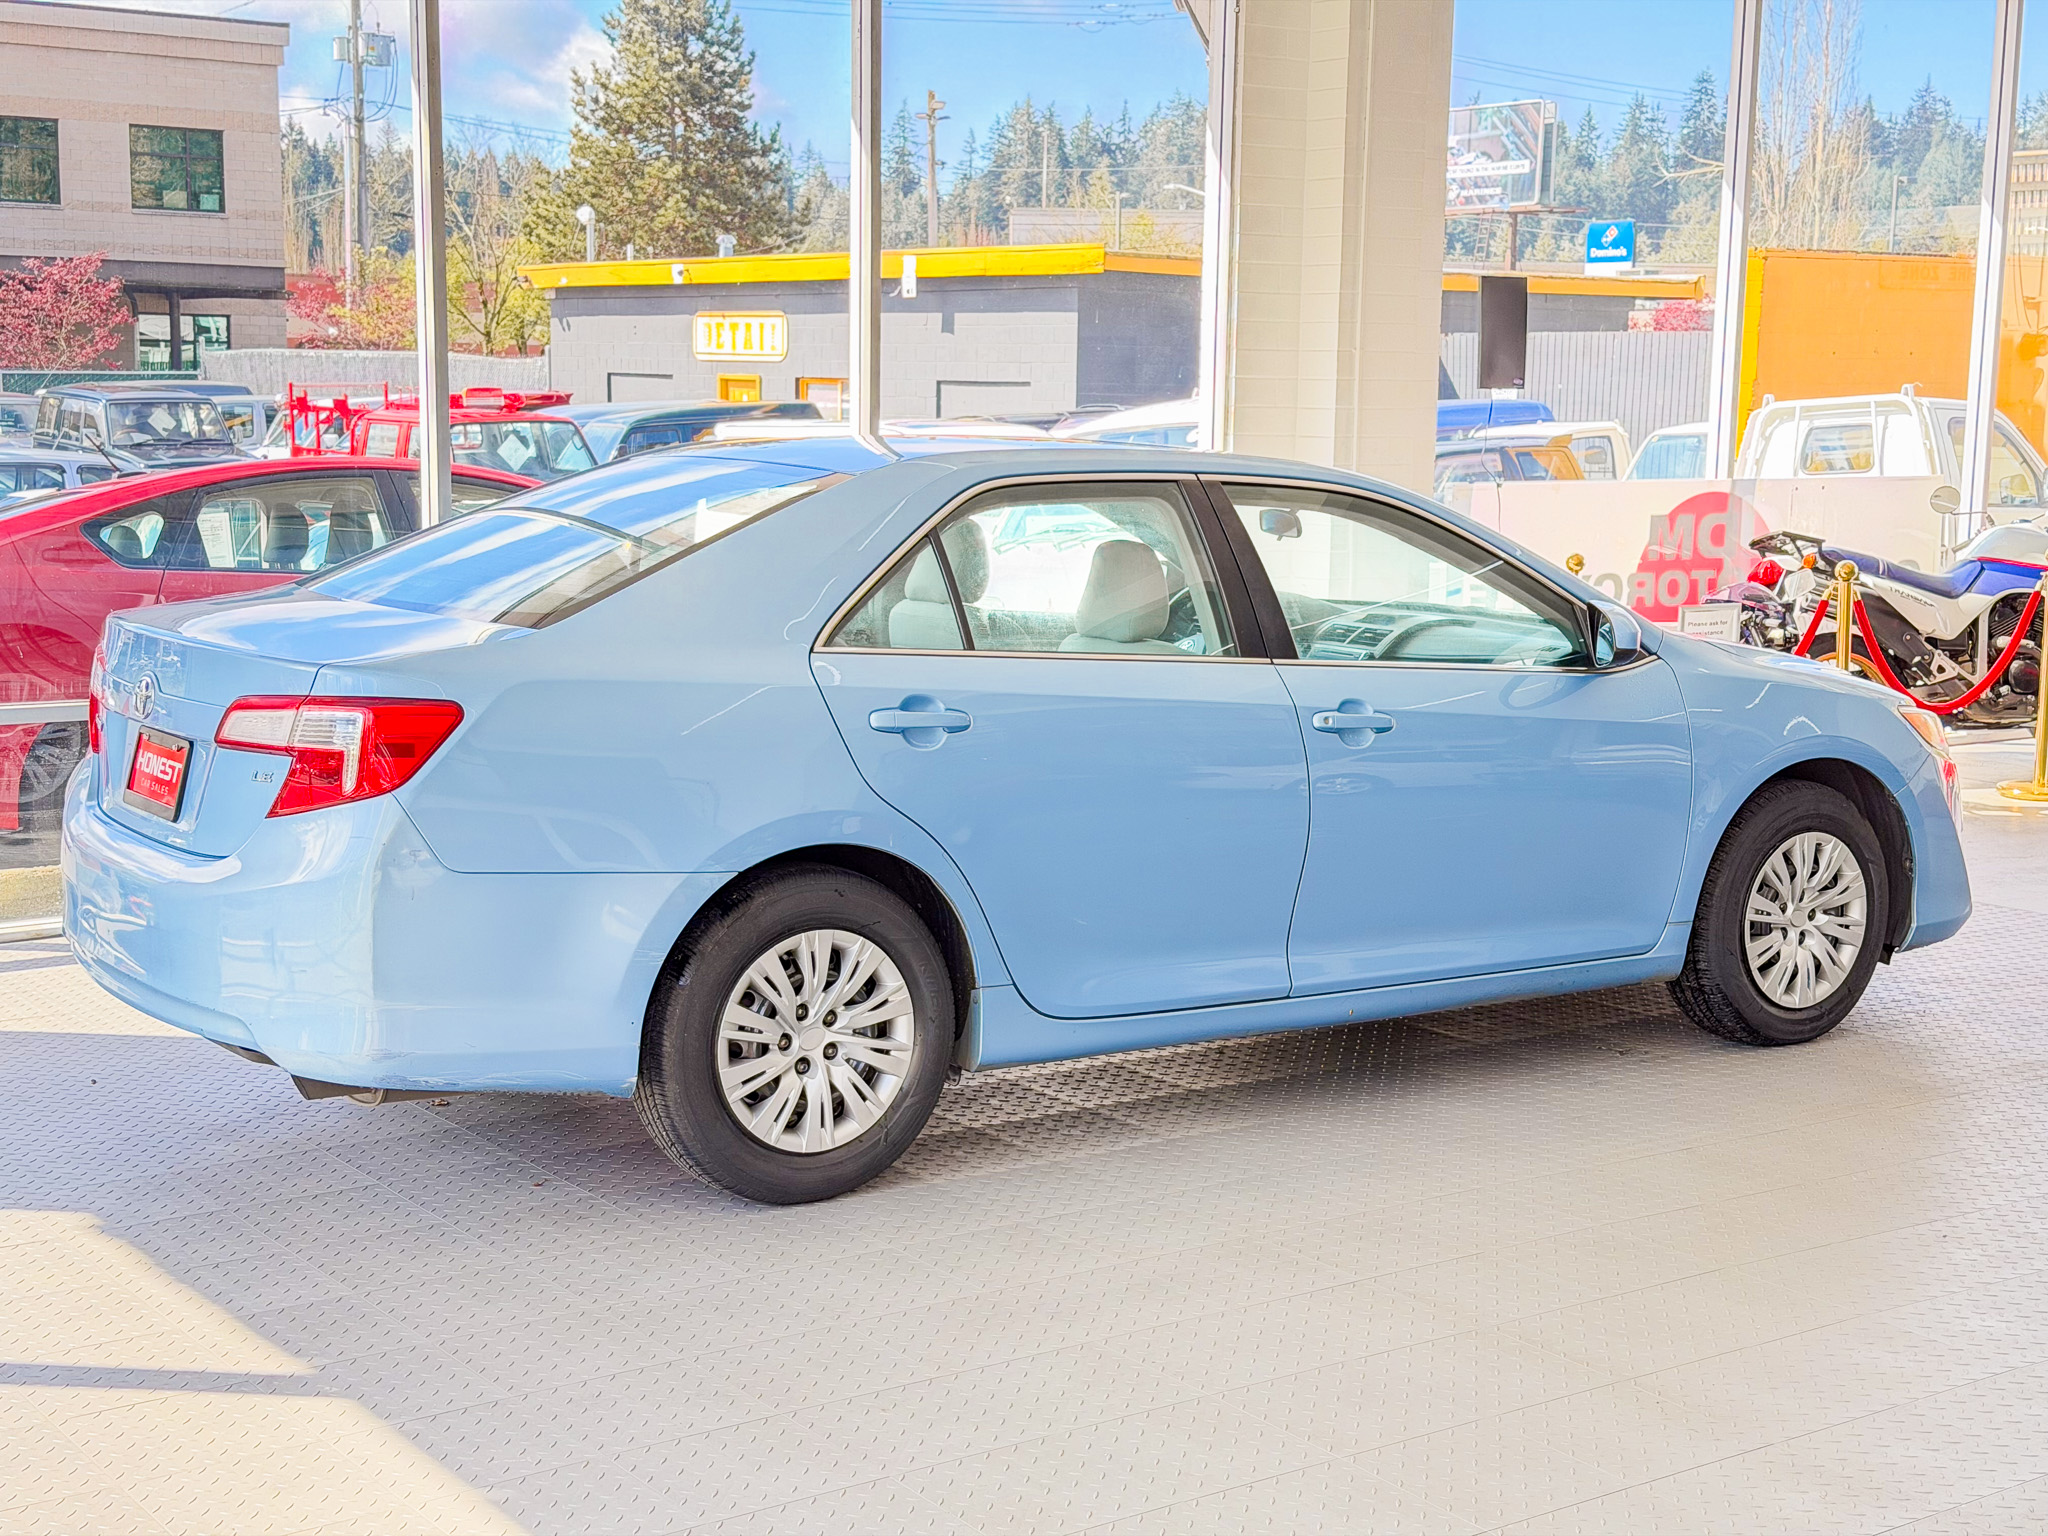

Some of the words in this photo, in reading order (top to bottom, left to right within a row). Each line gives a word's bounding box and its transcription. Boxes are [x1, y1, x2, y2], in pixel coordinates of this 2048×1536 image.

[1590, 246, 1627, 258] Domino's
[136, 749, 183, 783] HONEST
[251, 770, 274, 783] LE
[140, 777, 151, 789] CAR
[151, 782, 169, 796] SALES
